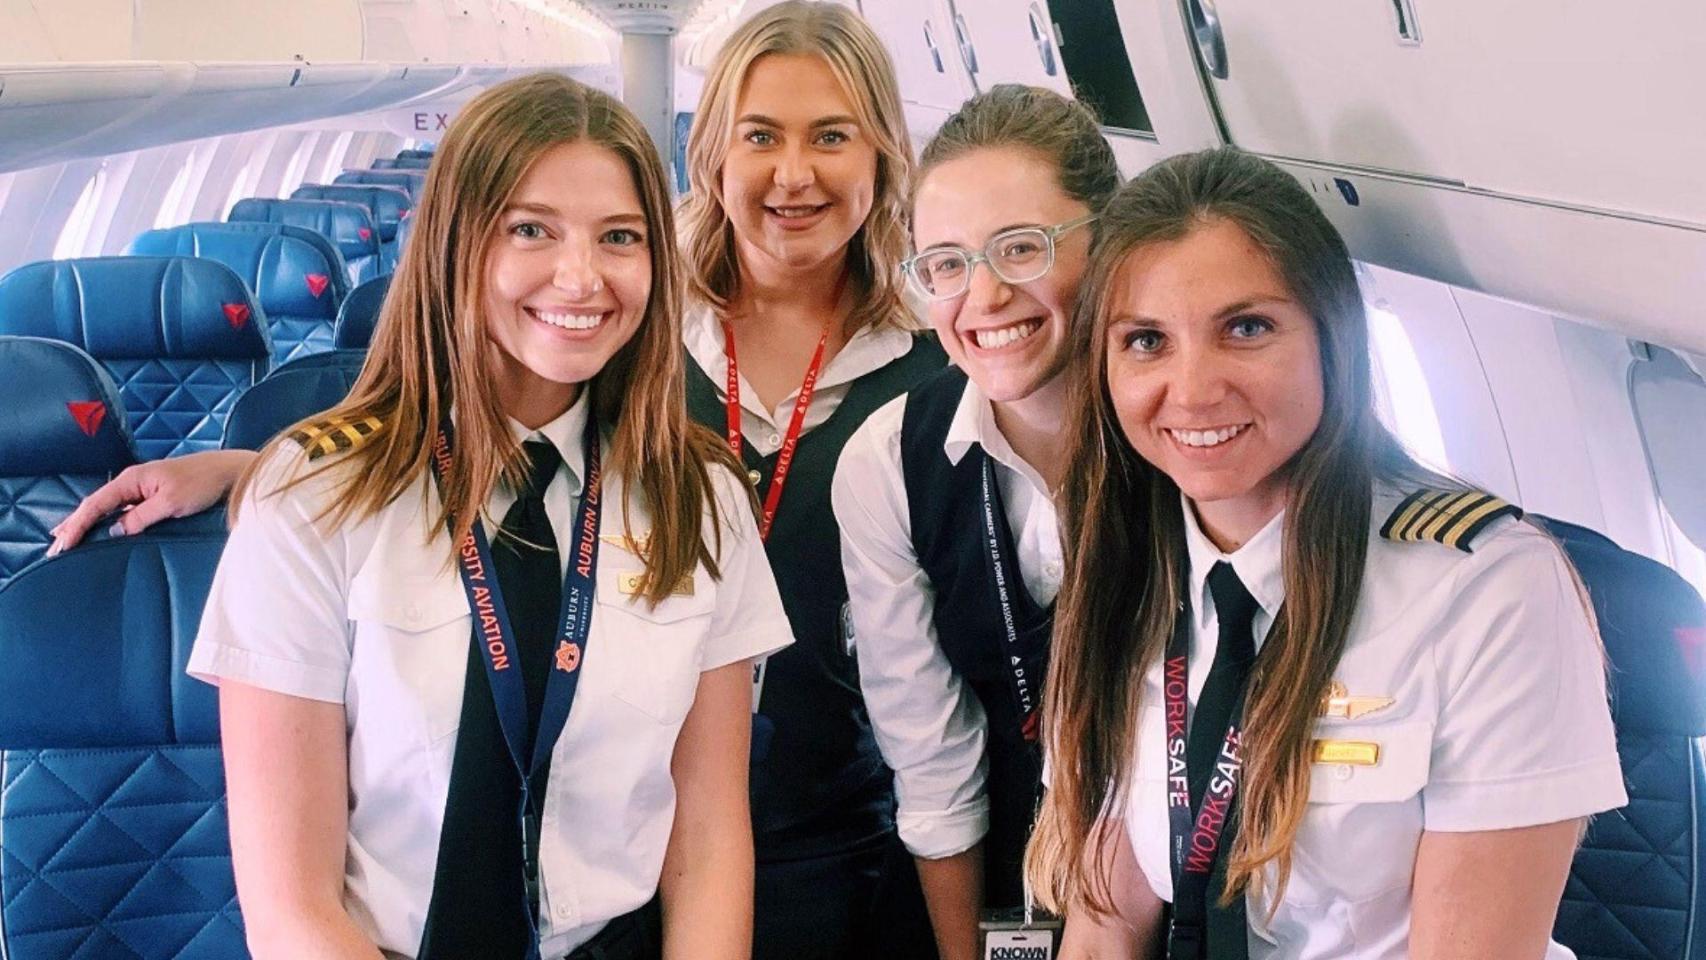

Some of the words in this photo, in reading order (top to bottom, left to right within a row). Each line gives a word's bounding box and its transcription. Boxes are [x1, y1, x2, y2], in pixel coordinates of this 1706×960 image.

[414, 113, 448, 131] EX
[728, 368, 738, 404] DELTA
[800, 370, 816, 404] DELTA
[777, 438, 797, 474] DELTA
[576, 506, 597, 578] AUBURN
[472, 586, 510, 671] AVIATION
[564, 586, 579, 639] AUBURN
[1015, 668, 1032, 713] DELTA
[1166, 656, 1189, 808] WORKSAFE
[990, 946, 1048, 960] KNOWN
